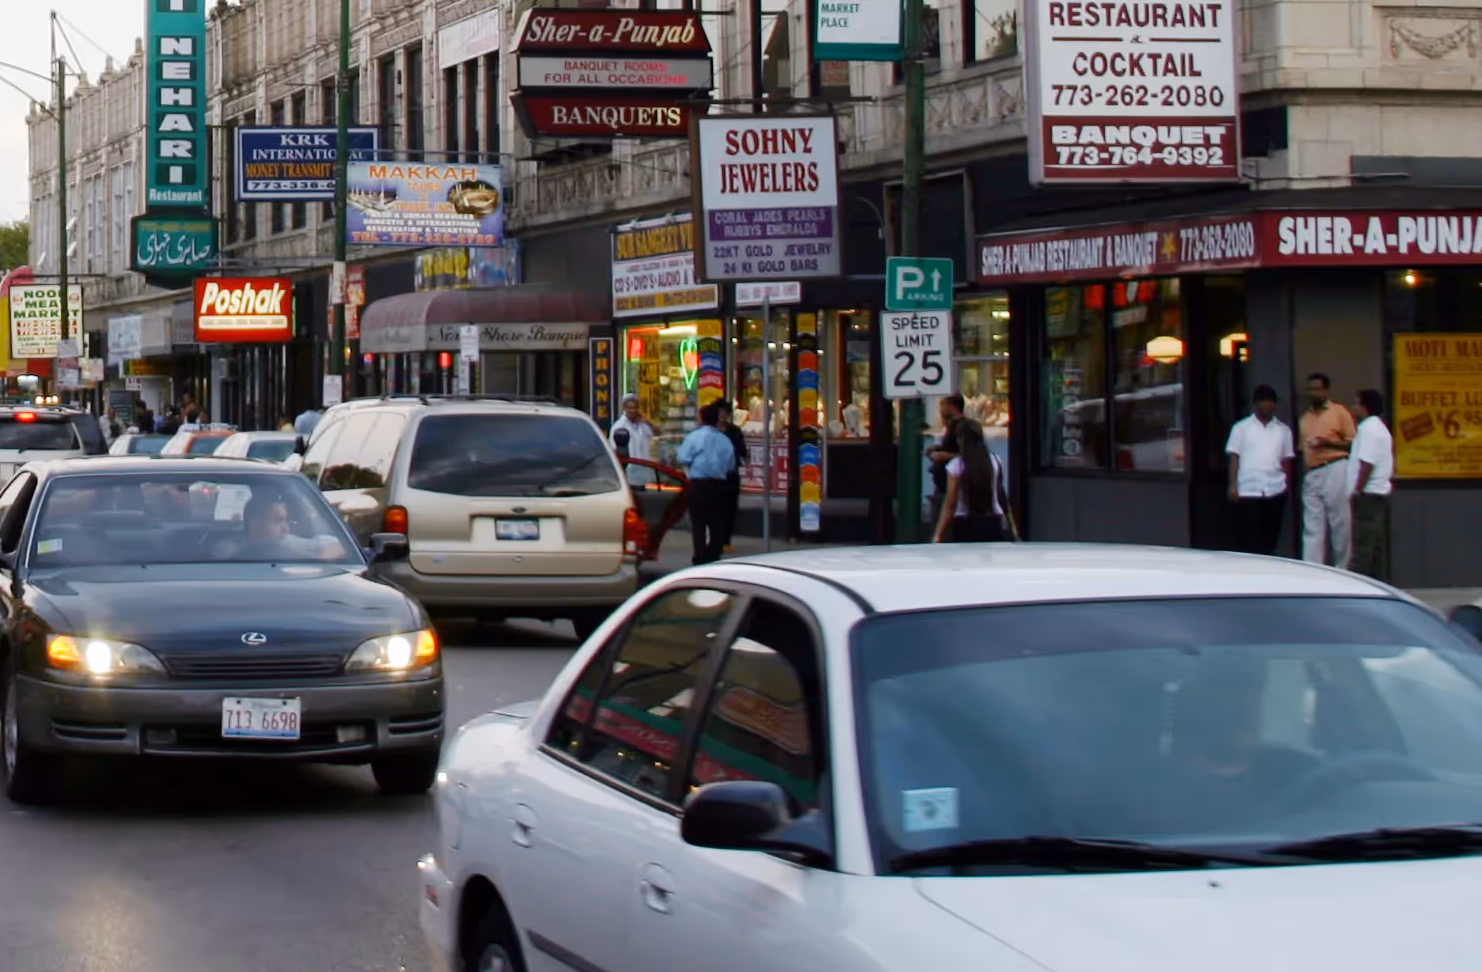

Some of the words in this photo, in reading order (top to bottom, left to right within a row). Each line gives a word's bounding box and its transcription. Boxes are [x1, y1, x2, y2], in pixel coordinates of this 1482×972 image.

[821, 3, 860, 14] MARKET
[1049, 2, 1223, 28] RESTAURANT
[820, 18, 849, 28] PLACE
[525, 16, 696, 47] Sher-a-Punjab
[564, 60, 619, 72] BANQUET
[624, 61, 668, 73] ROOMS
[1072, 51, 1203, 77] COCKTAIL
[544, 73, 572, 84] FOR
[578, 74, 602, 84] ALL
[1051, 84, 1224, 107] 773-262-2080
[158, 36, 195, 185] NEHARI
[551, 105, 682, 129] BANQUETS
[280, 133, 330, 146] KRK
[724, 127, 814, 157] SOHNY
[1051, 124, 1227, 145] BANQUET
[252, 148, 367, 161] INTERNATIOAL
[1055, 146, 1224, 166] 773-764-9392
[245, 163, 279, 178] MONEY
[283, 163, 336, 178] TRANSMIT
[369, 164, 478, 182] MAKKAH
[720, 161, 820, 194] JEWELERS
[149, 188, 203, 202] Restaurant
[714, 211, 748, 225] CORAL
[745, 244, 773, 258] GOLD
[784, 242, 832, 257] JEWELRY
[1046, 236, 1104, 272] RESTAURANT
[1114, 231, 1159, 267] BANQUET
[1179, 221, 1256, 262] 773-262-2080
[758, 260, 785, 273] GOLD
[790, 258, 818, 271] BARS
[23, 289, 61, 299] NOO
[200, 282, 286, 315] Poshak
[25, 300, 60, 309] MEA
[13, 309, 80, 319] MARKT
[891, 316, 940, 330] SPEED
[895, 333, 935, 348] LIMIT
[893, 350, 945, 386] 25
[595, 340, 609, 419] PHONE
[1400, 390, 1458, 407] BUFFET
